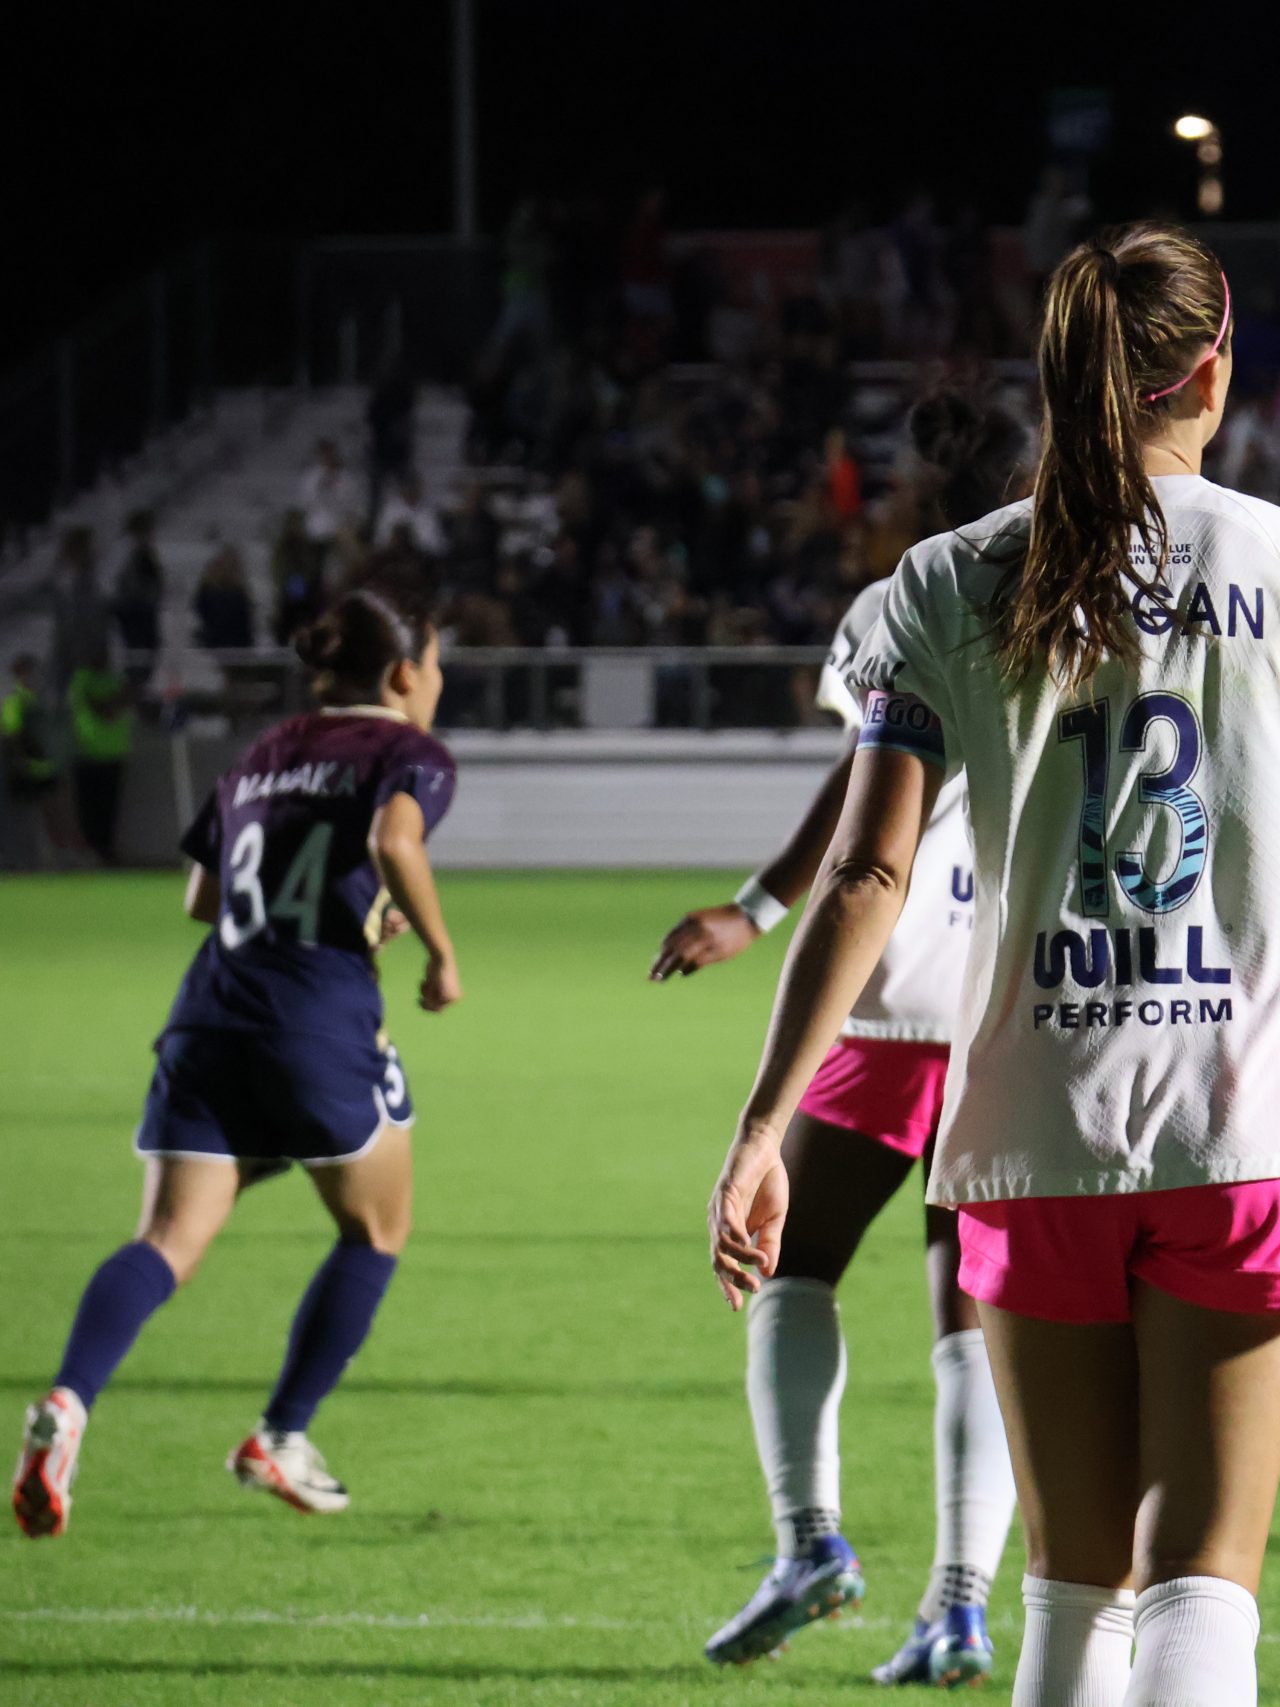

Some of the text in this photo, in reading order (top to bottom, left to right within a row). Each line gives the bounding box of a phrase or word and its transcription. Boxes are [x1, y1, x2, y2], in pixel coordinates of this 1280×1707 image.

[1057, 690, 1209, 917] 13
[219, 821, 334, 951] 34
[1033, 925, 1232, 989] WILL
[1033, 998, 1233, 1030] PERFORM
